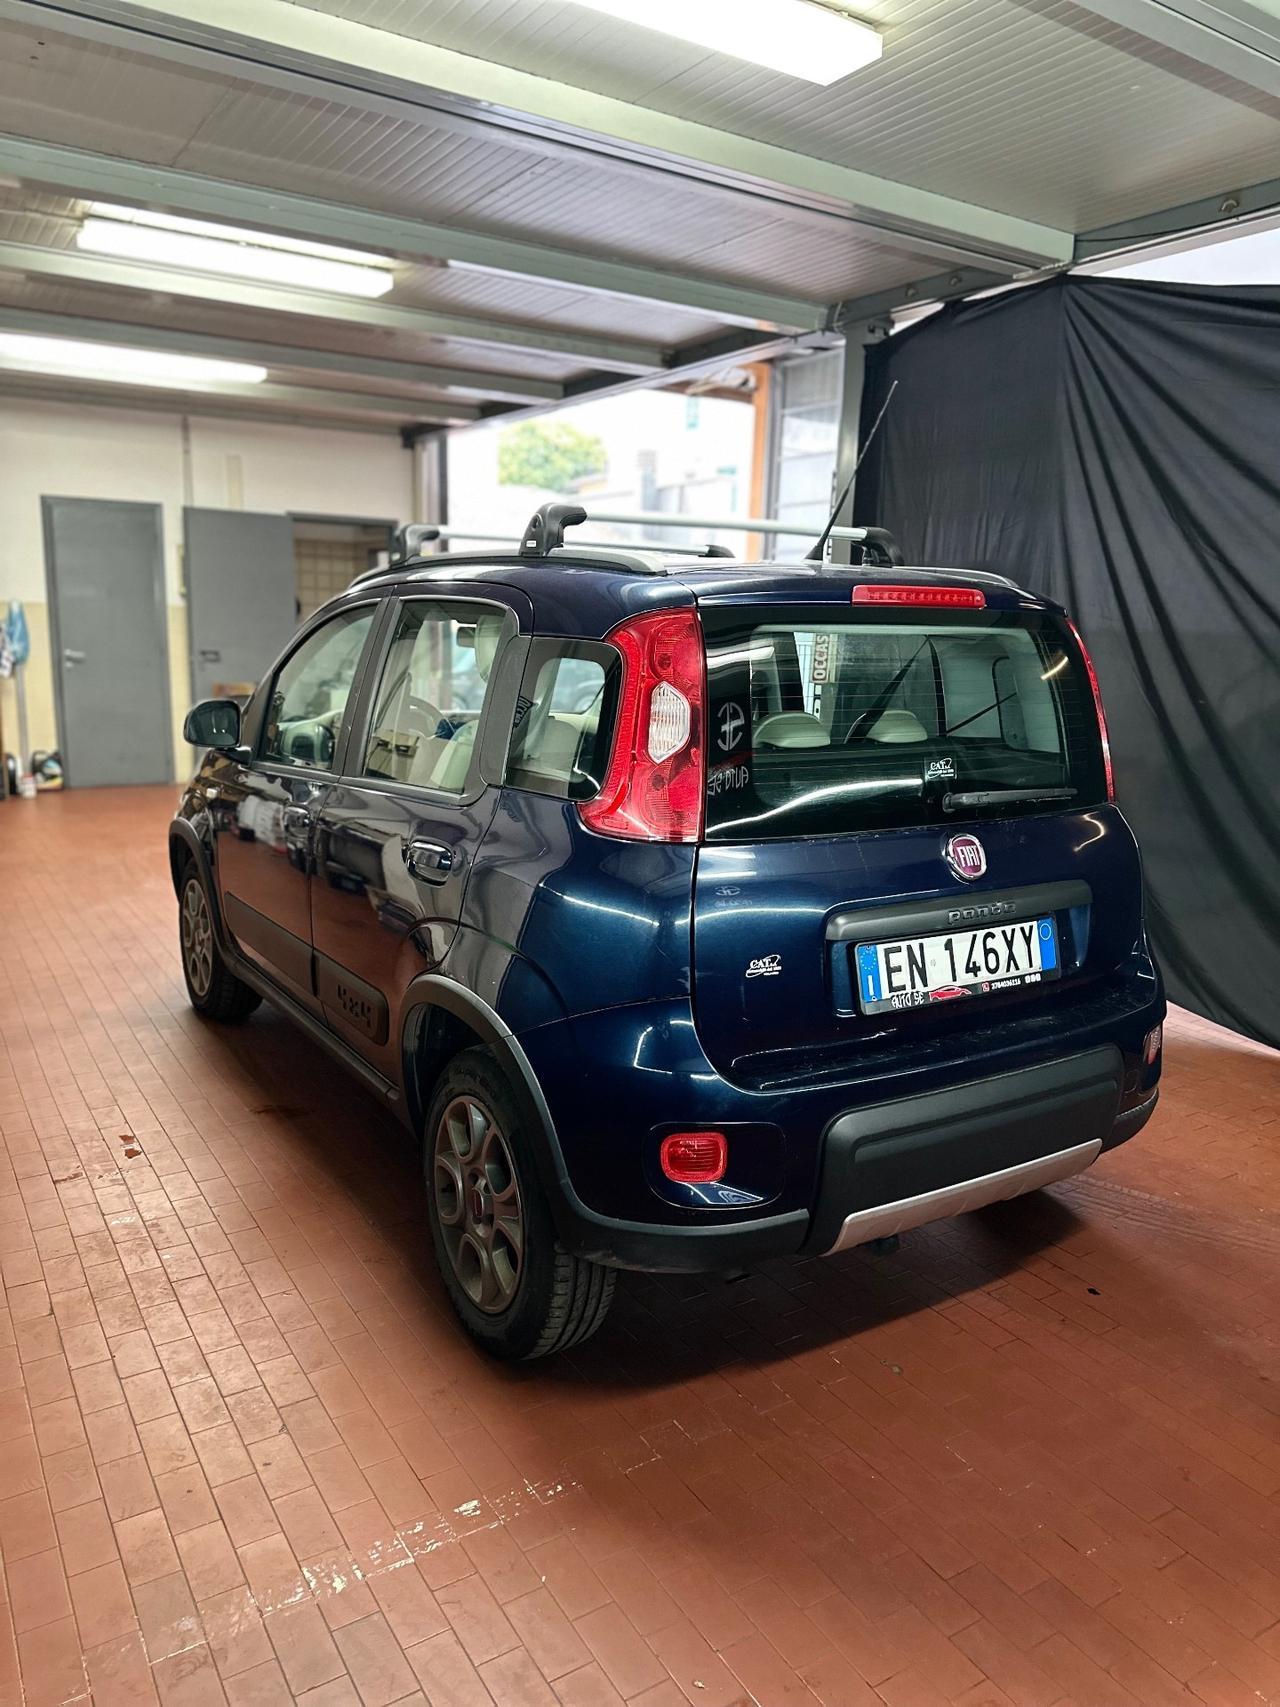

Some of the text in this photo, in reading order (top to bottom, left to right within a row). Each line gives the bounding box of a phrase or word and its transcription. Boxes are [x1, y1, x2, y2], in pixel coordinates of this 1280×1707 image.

[957, 845, 981, 868] FIAT
[883, 942, 928, 993] EN
[944, 924, 1034, 982] 146XY
[891, 990, 925, 1009] AUTO SE
